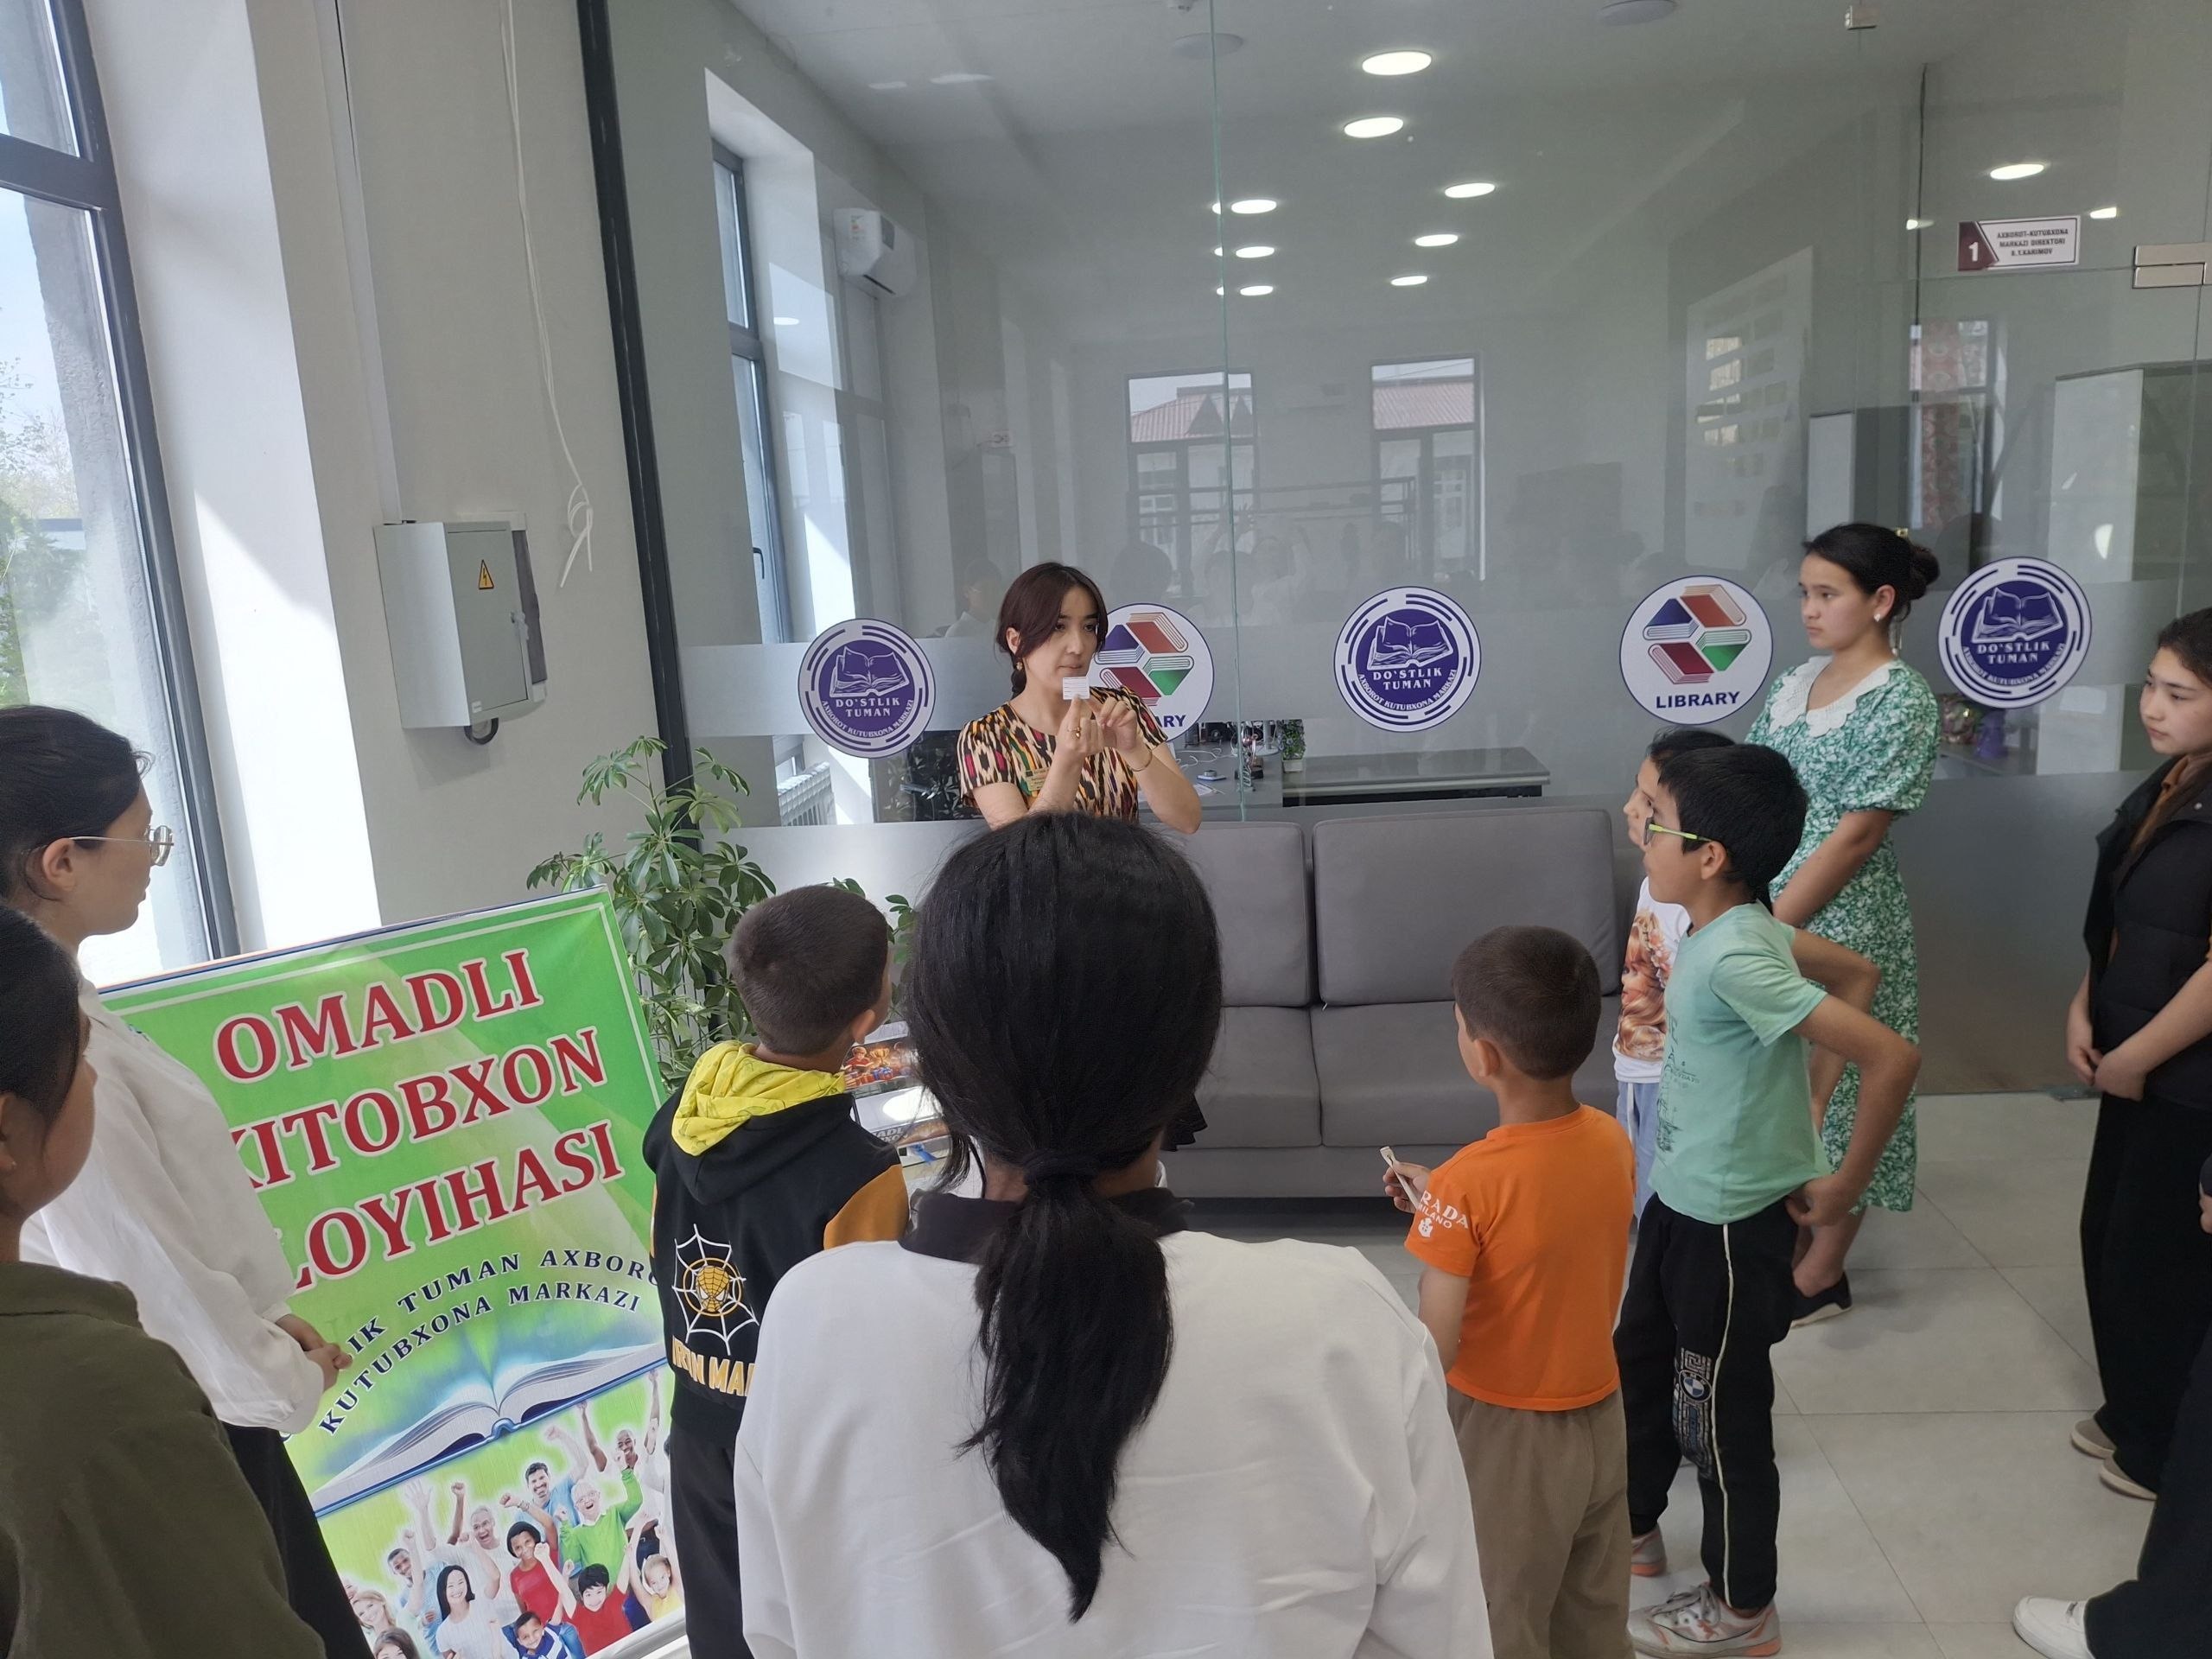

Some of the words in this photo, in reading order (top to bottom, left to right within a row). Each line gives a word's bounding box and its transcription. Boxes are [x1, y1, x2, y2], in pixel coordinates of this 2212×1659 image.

[1968, 241, 1979, 261] 1
[1988, 652, 2038, 664] TUMAN
[1383, 678, 1431, 690] TUMAN
[1384, 697, 1433, 710] KUTUBXONA
[1433, 669, 1457, 701] MARKAZI
[846, 708, 891, 717] TUMAN
[1656, 691, 1740, 709] LIBRARY
[848, 727, 893, 737] KUTUBXONA
[216, 951, 540, 1080] OMADLI
[296, 1122, 622, 1288] OYIHASI
[1420, 1190, 1469, 1229] RADA
[397, 1254, 519, 1314] TUMAN
[319, 1297, 493, 1434] KUTUBXONA
[509, 1281, 641, 1313] MARKAZI
